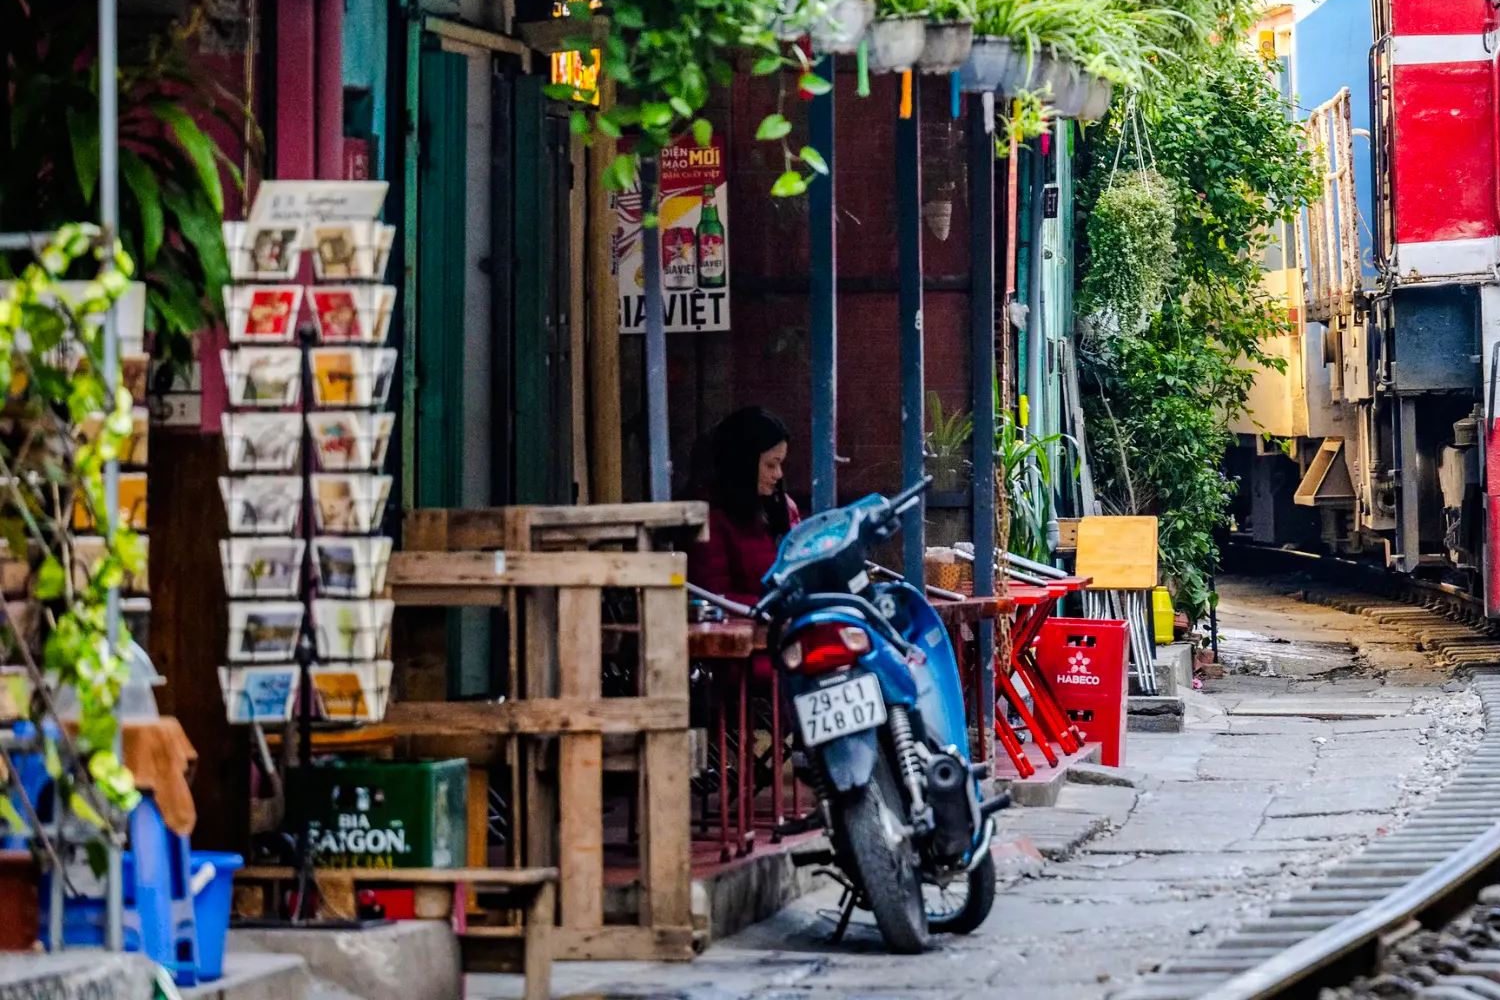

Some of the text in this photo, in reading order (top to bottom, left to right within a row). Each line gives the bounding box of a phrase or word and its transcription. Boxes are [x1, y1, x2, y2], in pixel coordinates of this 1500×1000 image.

[1057, 675, 1100, 685] HABECO
[808, 682, 864, 716] 29-C1
[338, 813, 371, 829] BIA
